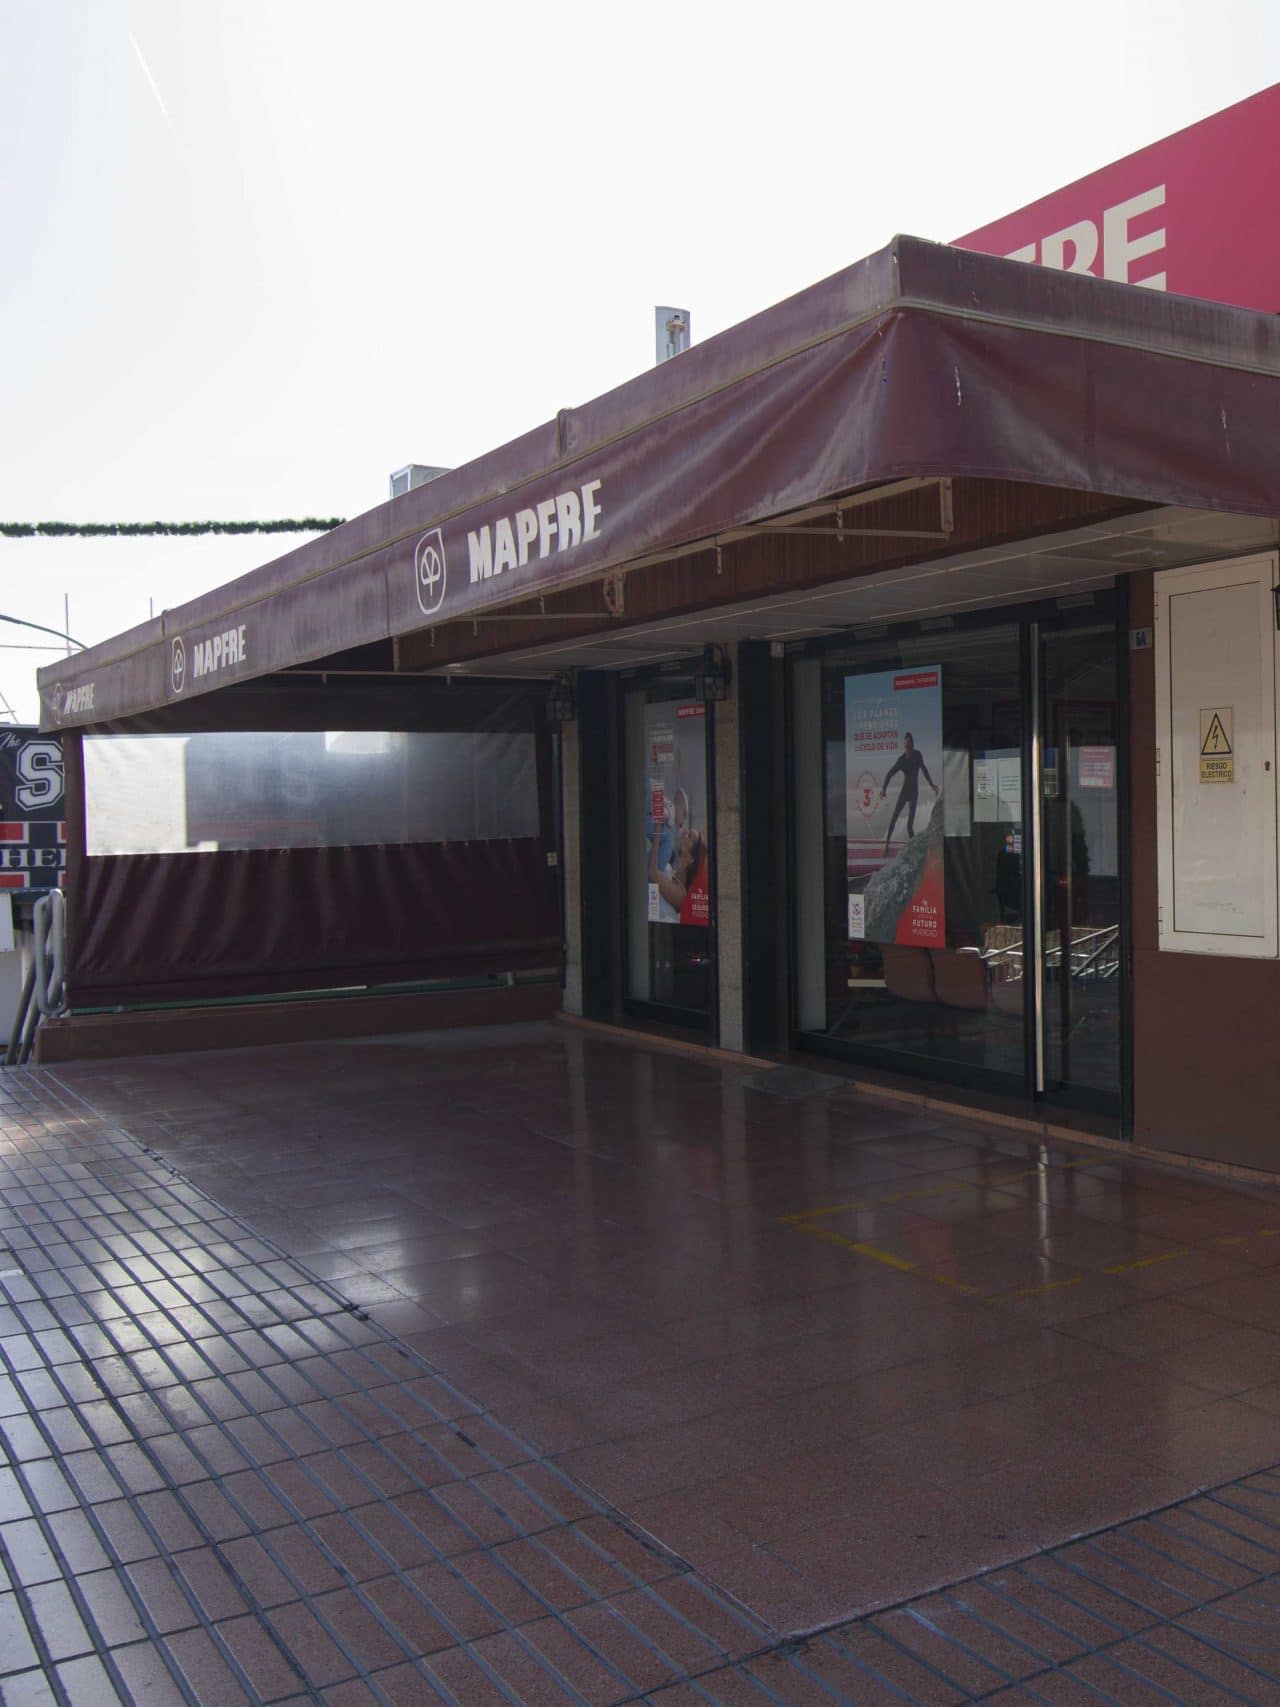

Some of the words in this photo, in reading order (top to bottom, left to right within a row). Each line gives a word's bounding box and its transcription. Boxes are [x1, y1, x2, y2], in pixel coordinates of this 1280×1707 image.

[468, 478, 603, 584] MAPFRE
[193, 624, 247, 678] MAPFRE
[63, 683, 95, 715] MAPFRE
[1206, 762, 1227, 770] RIESGO
[912, 904, 937, 914] FAMILIA
[912, 919, 937, 929] FUTURO
